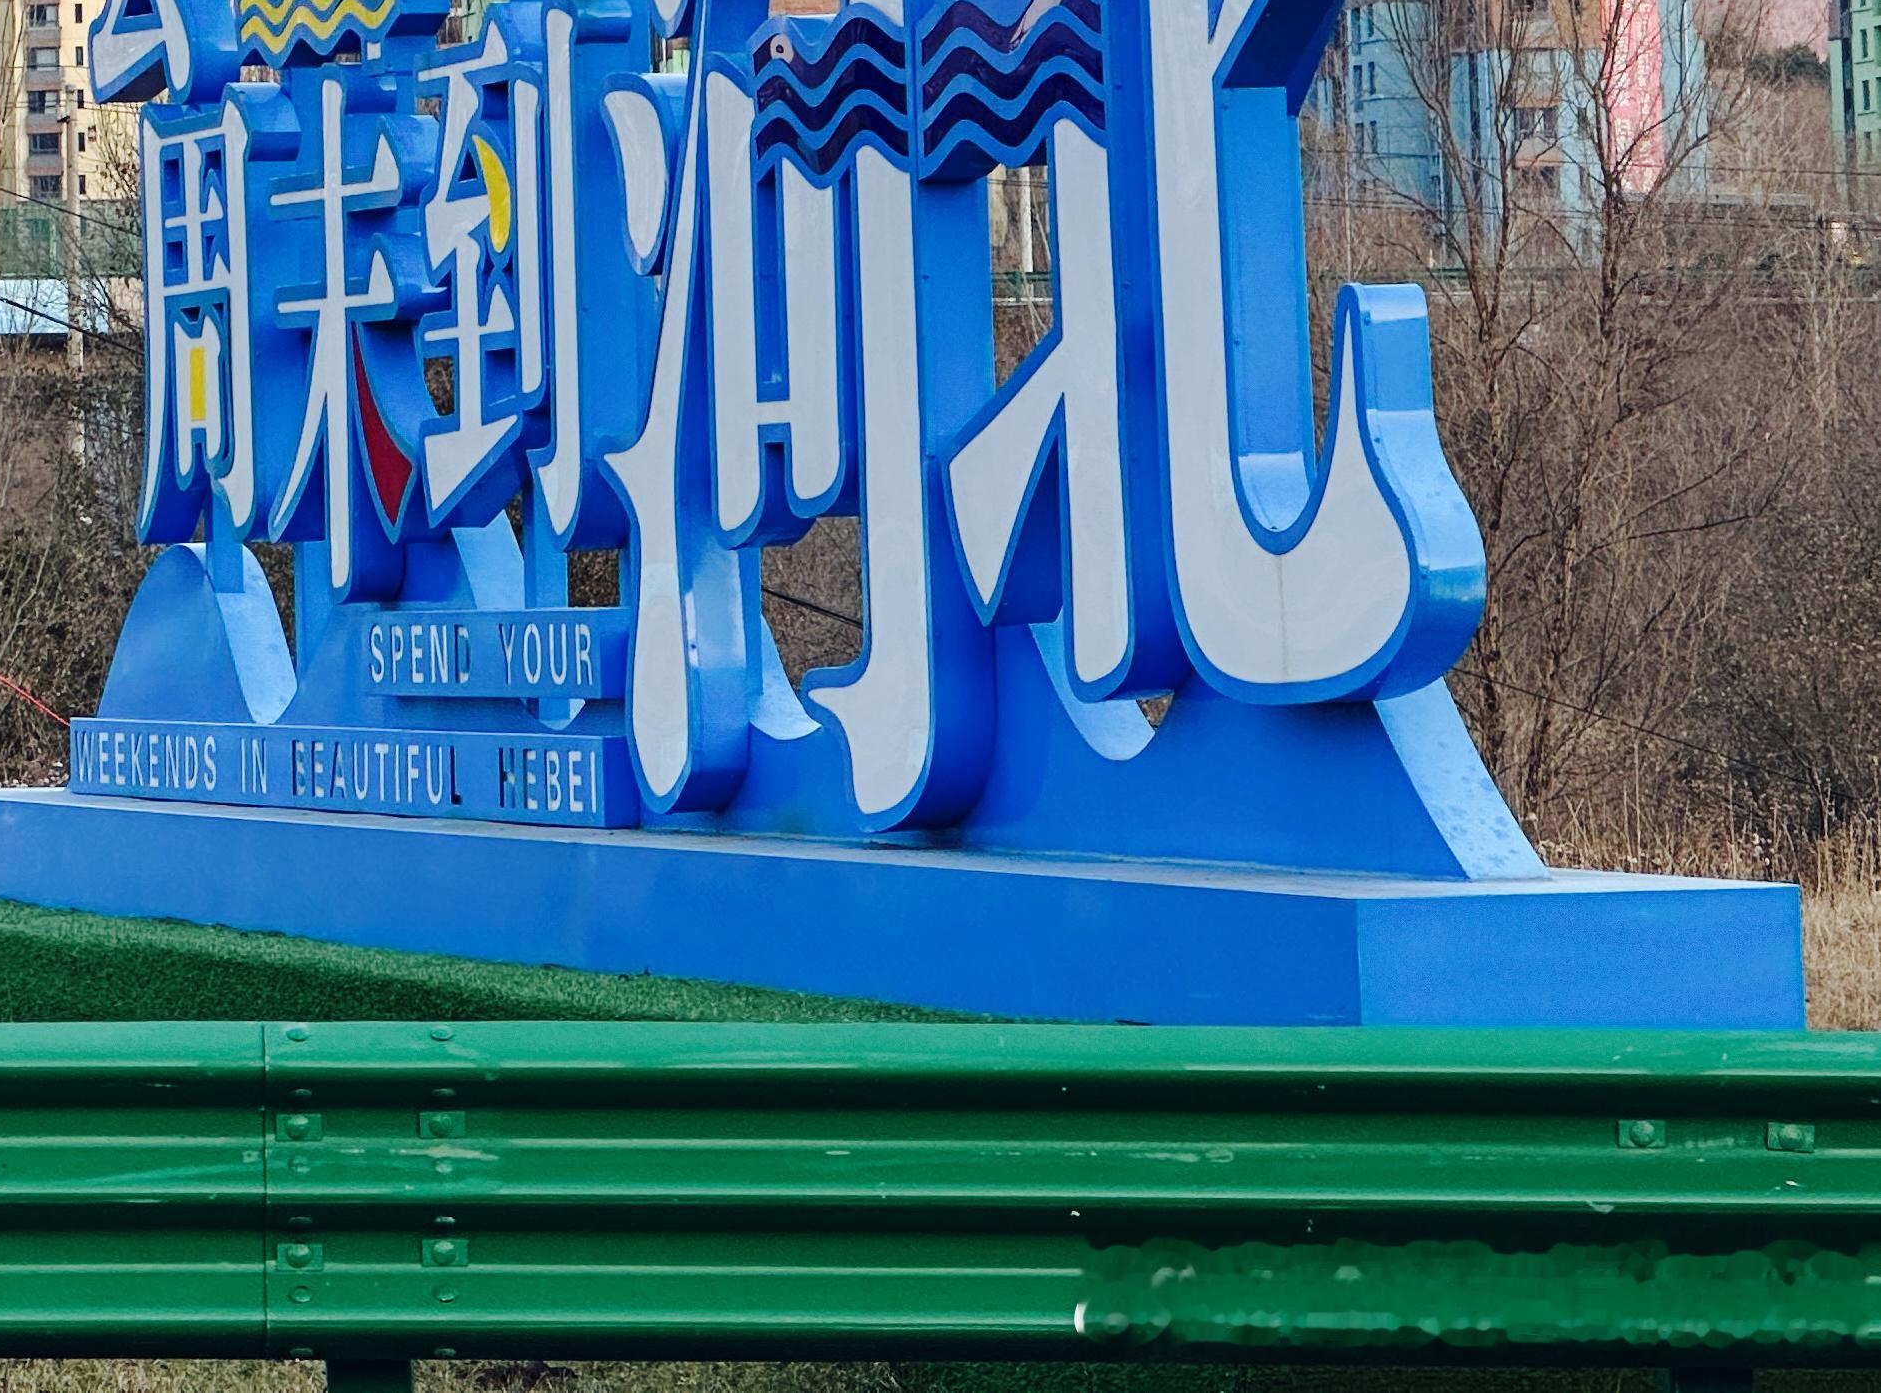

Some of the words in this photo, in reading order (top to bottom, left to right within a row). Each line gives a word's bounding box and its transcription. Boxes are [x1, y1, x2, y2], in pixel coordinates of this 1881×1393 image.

[369, 622, 471, 684] SPEND
[499, 623, 594, 687] YOUR
[74, 729, 217, 792] WEEKENDS
[240, 737, 268, 796] IN
[291, 739, 463, 806] BEAUTIFUL
[499, 747, 597, 815] HEBEI
